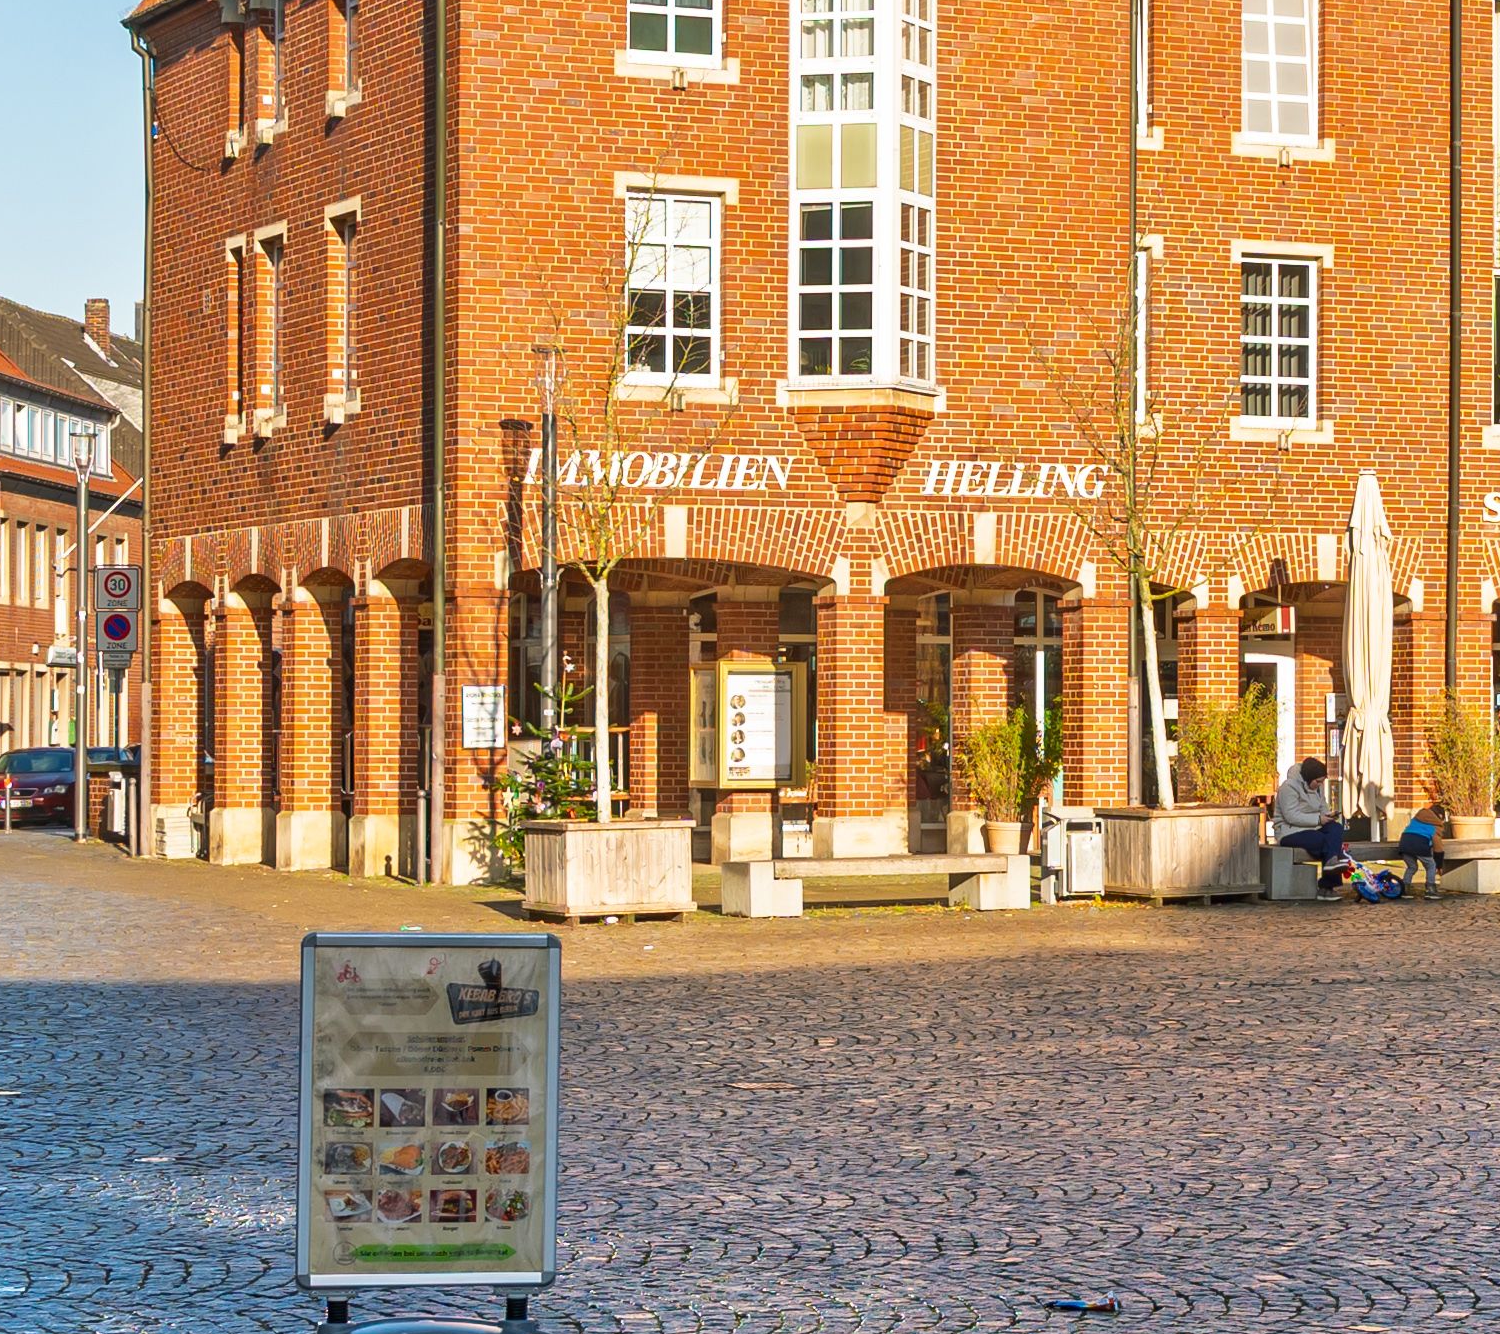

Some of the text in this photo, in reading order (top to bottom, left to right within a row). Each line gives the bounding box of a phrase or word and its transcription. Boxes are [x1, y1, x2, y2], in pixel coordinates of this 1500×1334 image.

[523, 447, 1111, 499] IMMOBILIEN HELLING
[110, 578, 126, 591] 30
[107, 599, 128, 607] ZONE
[107, 642, 128, 650] ZONE
[458, 987, 498, 1003] KEBAB
